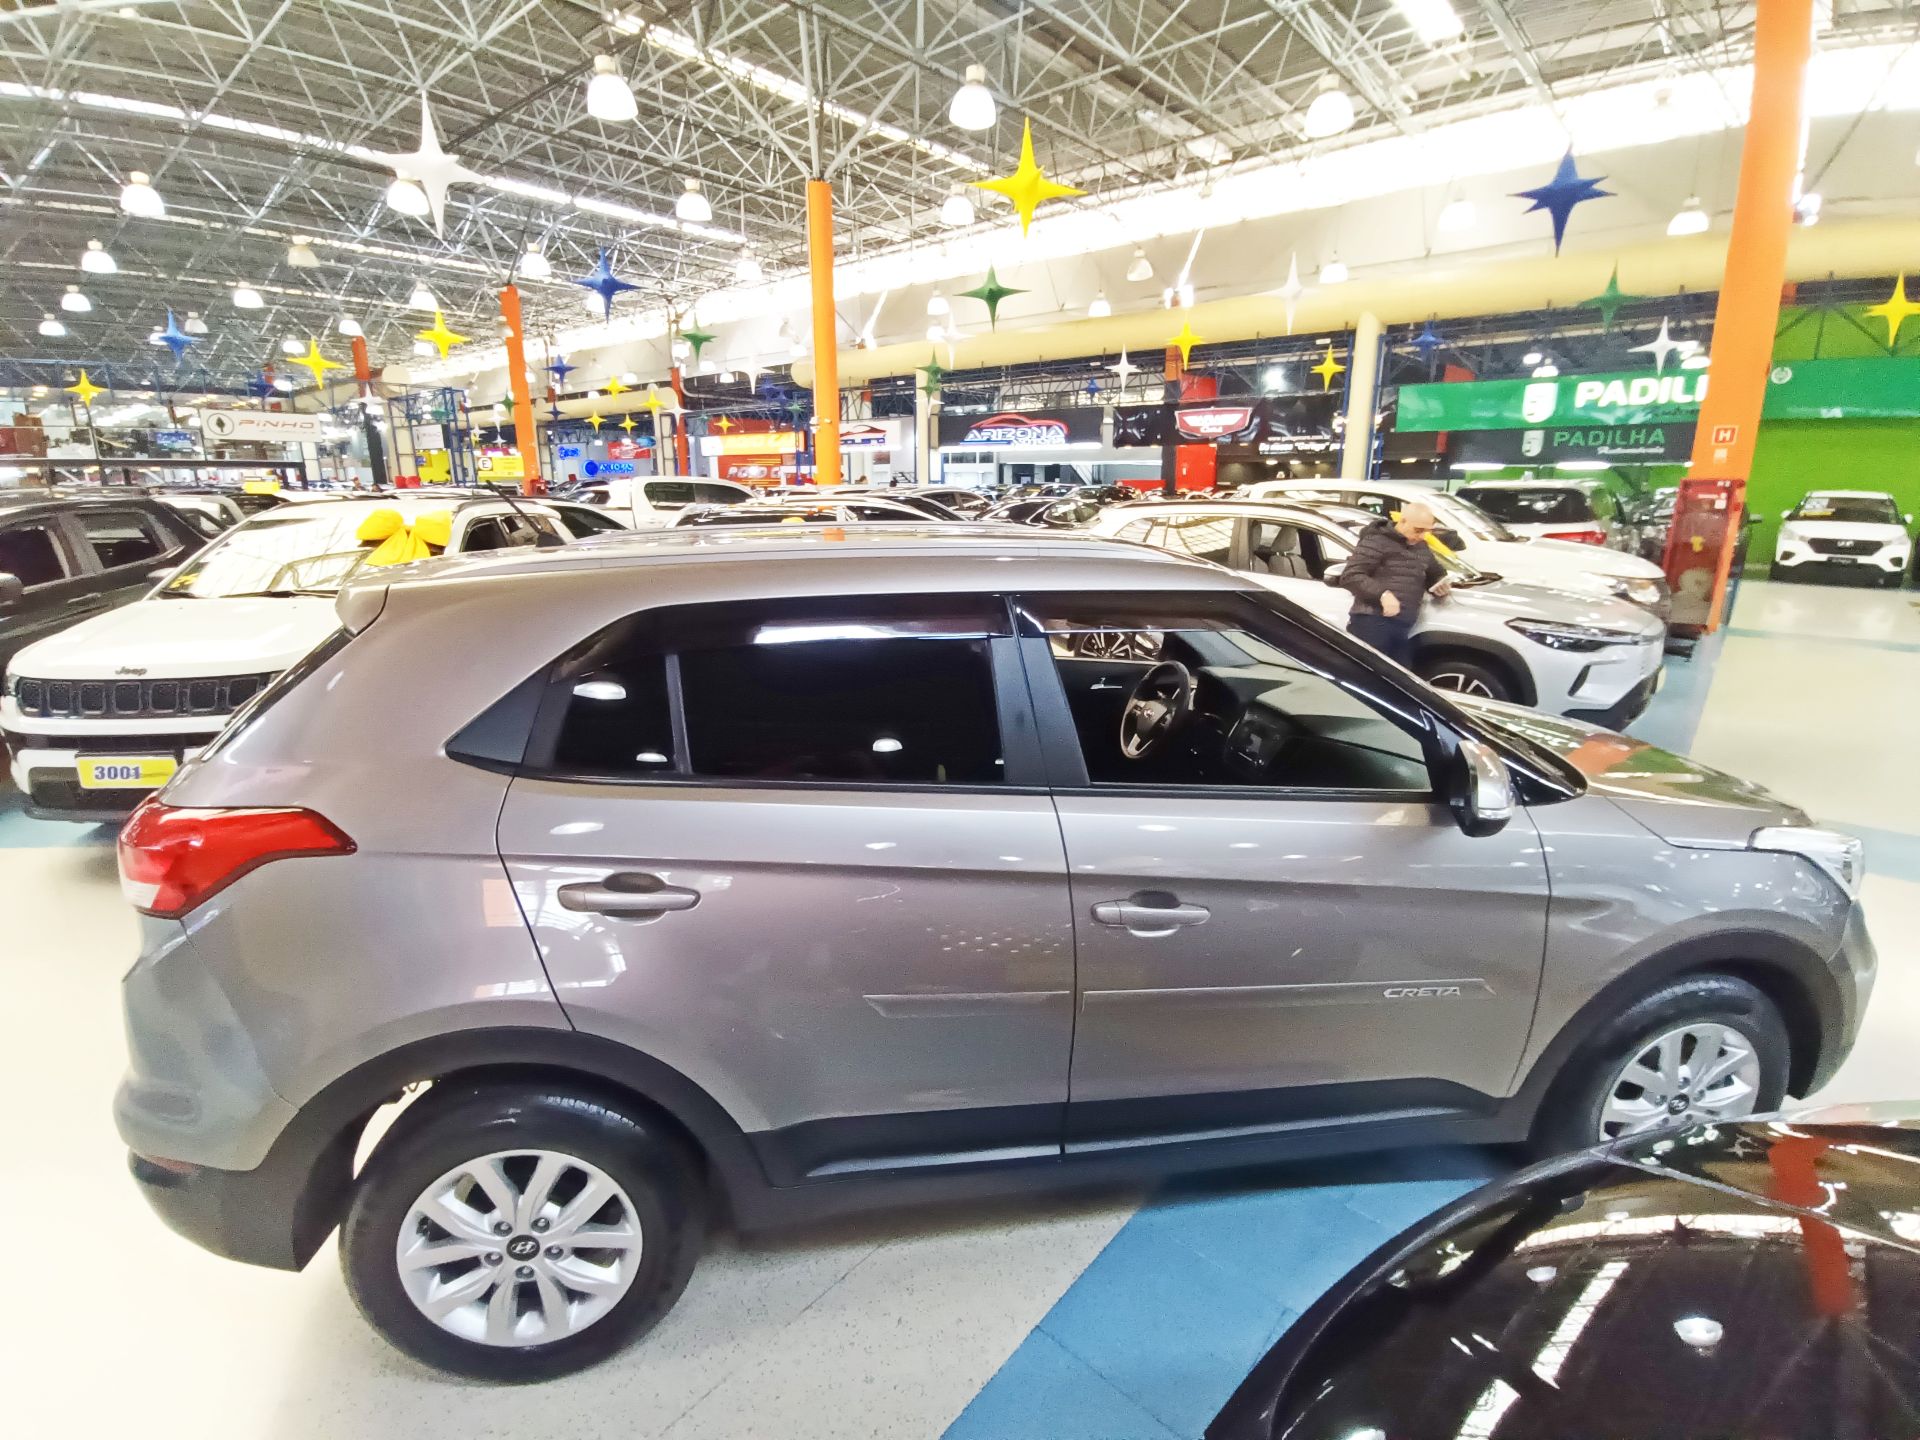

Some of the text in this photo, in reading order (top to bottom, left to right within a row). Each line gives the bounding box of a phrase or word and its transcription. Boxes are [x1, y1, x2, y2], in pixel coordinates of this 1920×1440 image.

[963, 425, 1066, 442] ARIZONA
[1553, 427, 1666, 448] PADILHA
[1718, 429, 1732, 442] H
[727, 466, 768, 479] ROD
[115, 666, 148, 676] Jeep
[94, 765, 141, 780] 3001
[1383, 986, 1461, 998] CRETA
